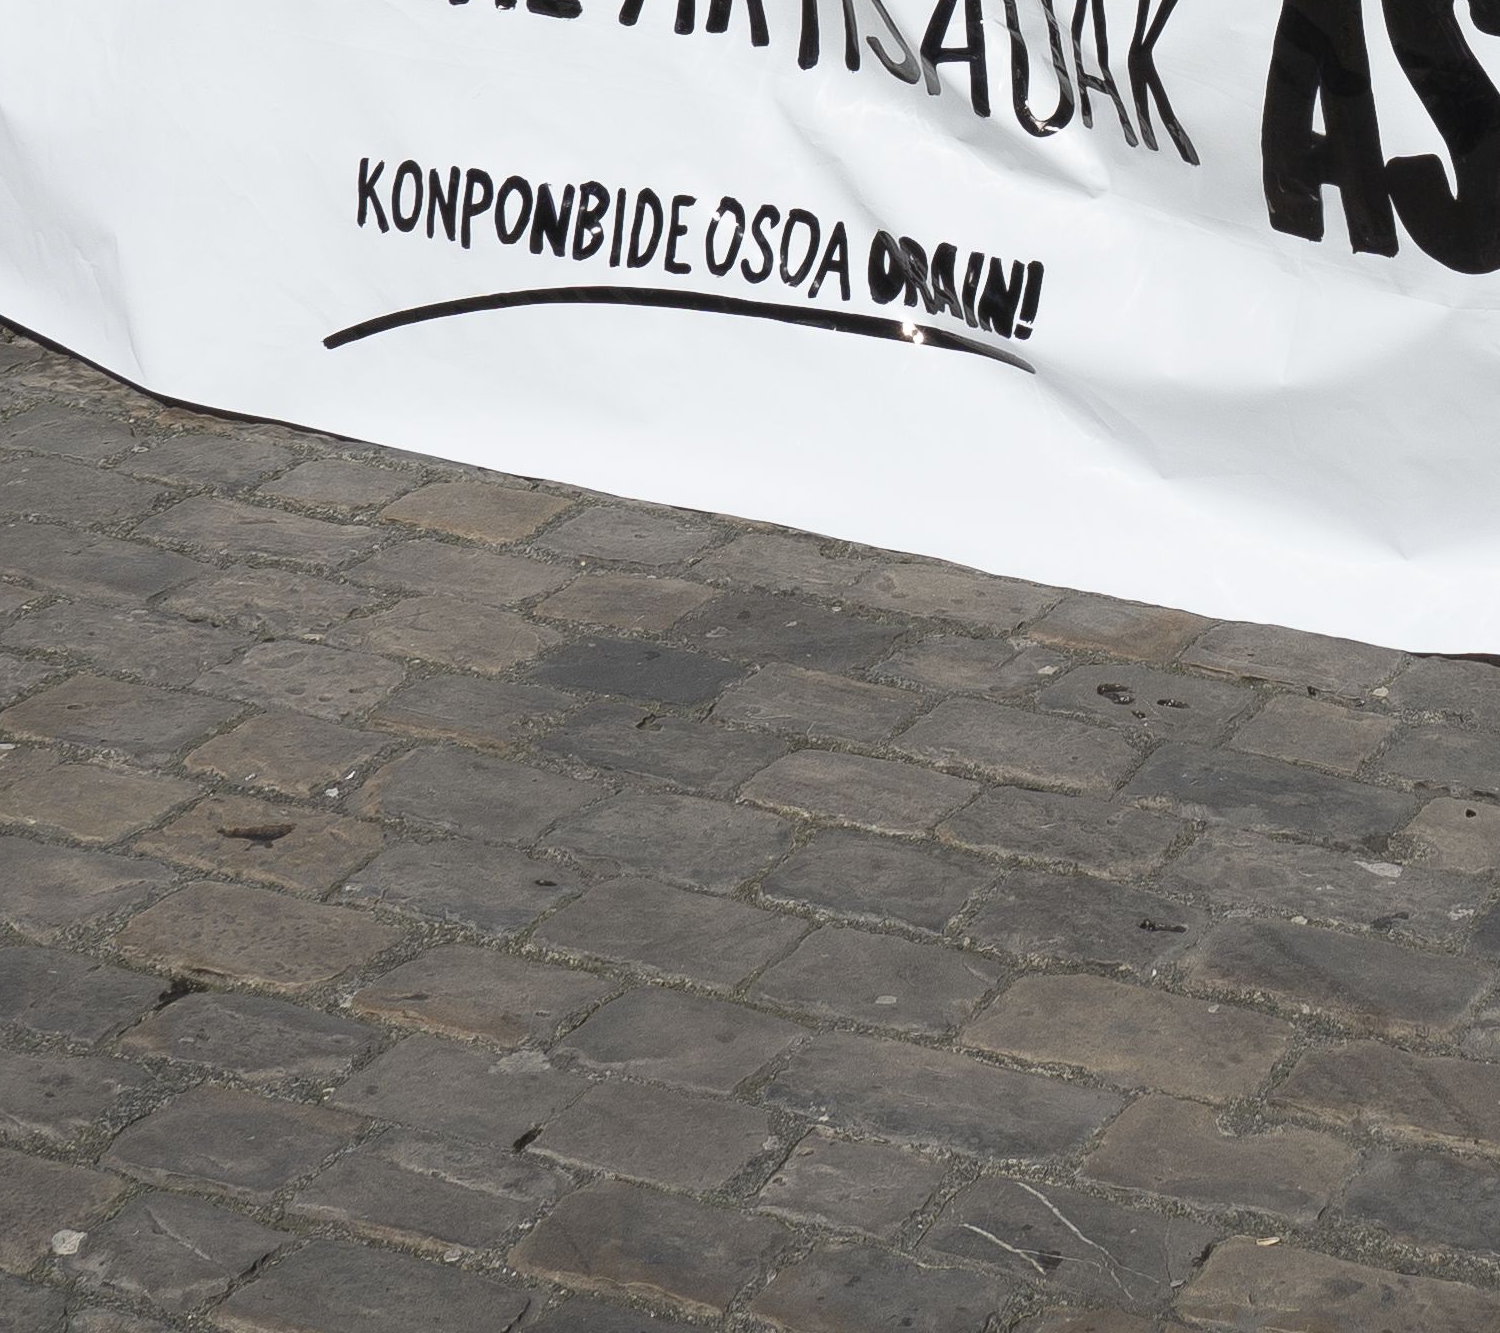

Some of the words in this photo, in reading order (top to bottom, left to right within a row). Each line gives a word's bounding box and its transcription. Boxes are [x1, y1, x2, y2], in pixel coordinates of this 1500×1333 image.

[357, 157, 698, 275] KONPONBIDE
[705, 195, 851, 302] OSOA
[867, 229, 1046, 340] ORAIN!
